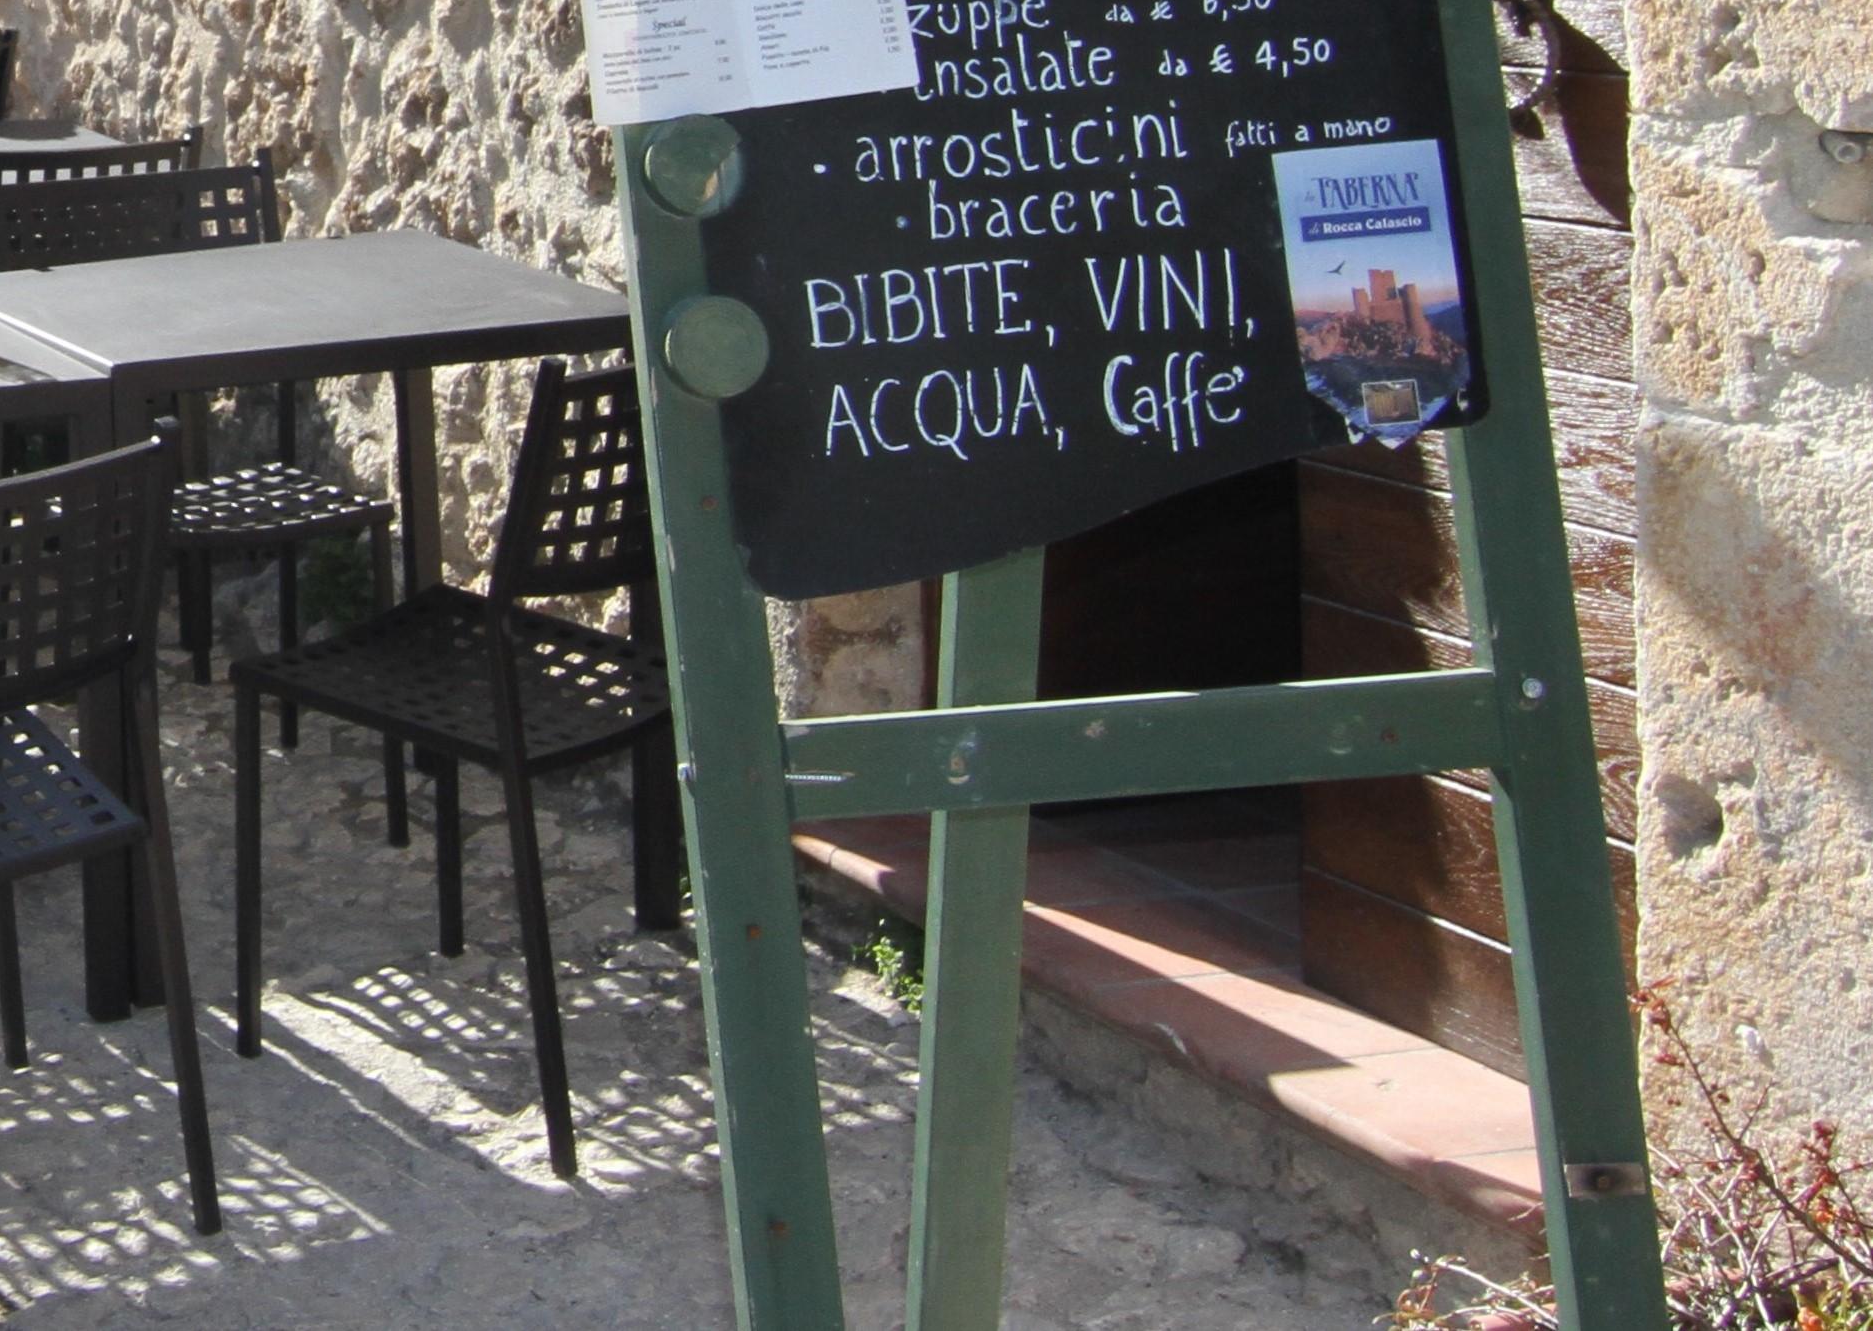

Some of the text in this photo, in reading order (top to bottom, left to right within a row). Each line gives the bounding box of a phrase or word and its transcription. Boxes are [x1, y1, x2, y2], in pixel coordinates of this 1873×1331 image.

[651, 15, 688, 33] Special
[1104, 1, 1135, 23] da
[1157, 49, 1189, 77] da
[1208, 43, 1234, 74] €
[1254, 36, 1332, 79] 4,50
[855, 98, 1392, 183] arrosticini fatti a mano
[928, 172, 1187, 241] braceria
[1311, 171, 1419, 211] TABERNA
[1308, 215, 1422, 236] di Rocca Calascio
[804, 247, 1257, 349] BIBITE, VINI,
[826, 363, 1067, 462] ACQUA,
